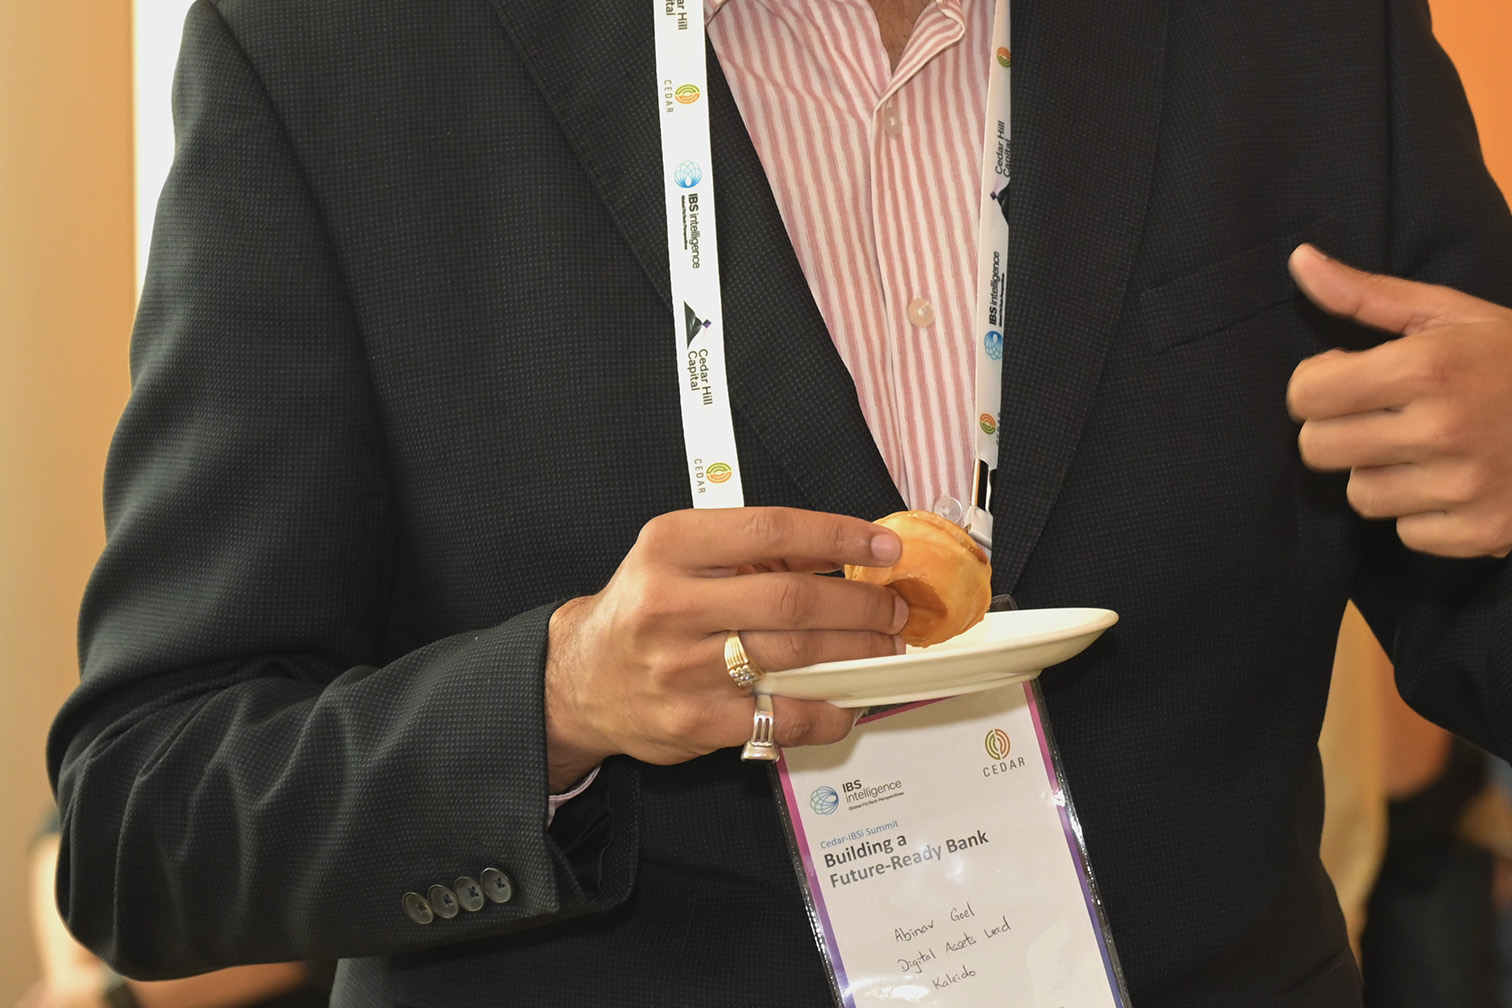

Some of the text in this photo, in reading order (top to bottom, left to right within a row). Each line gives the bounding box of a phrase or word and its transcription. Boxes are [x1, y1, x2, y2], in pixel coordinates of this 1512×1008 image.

[678, 11, 688, 31] Hill
[664, 79, 674, 114] CEDAR
[995, 120, 1005, 175] Cedar Hill
[688, 193, 701, 269] IBS intelligence
[988, 251, 1001, 326] IBS intelligence
[688, 351, 700, 391] Capital
[698, 349, 713, 405] Cedar Hill
[694, 458, 706, 494] CEDAR
[982, 756, 1026, 778] CEDAR
[842, 779, 862, 793] IBS
[845, 780, 902, 803] intelligence
[820, 820, 899, 849] Cedar-IBSi Summit
[824, 834, 907, 868] Building a
[830, 830, 989, 888] Future-Ready Bank
[950, 902, 975, 923] Goel
[897, 916, 1011, 974] Digital Assets Lead
[932, 965, 976, 990] Kaleido
